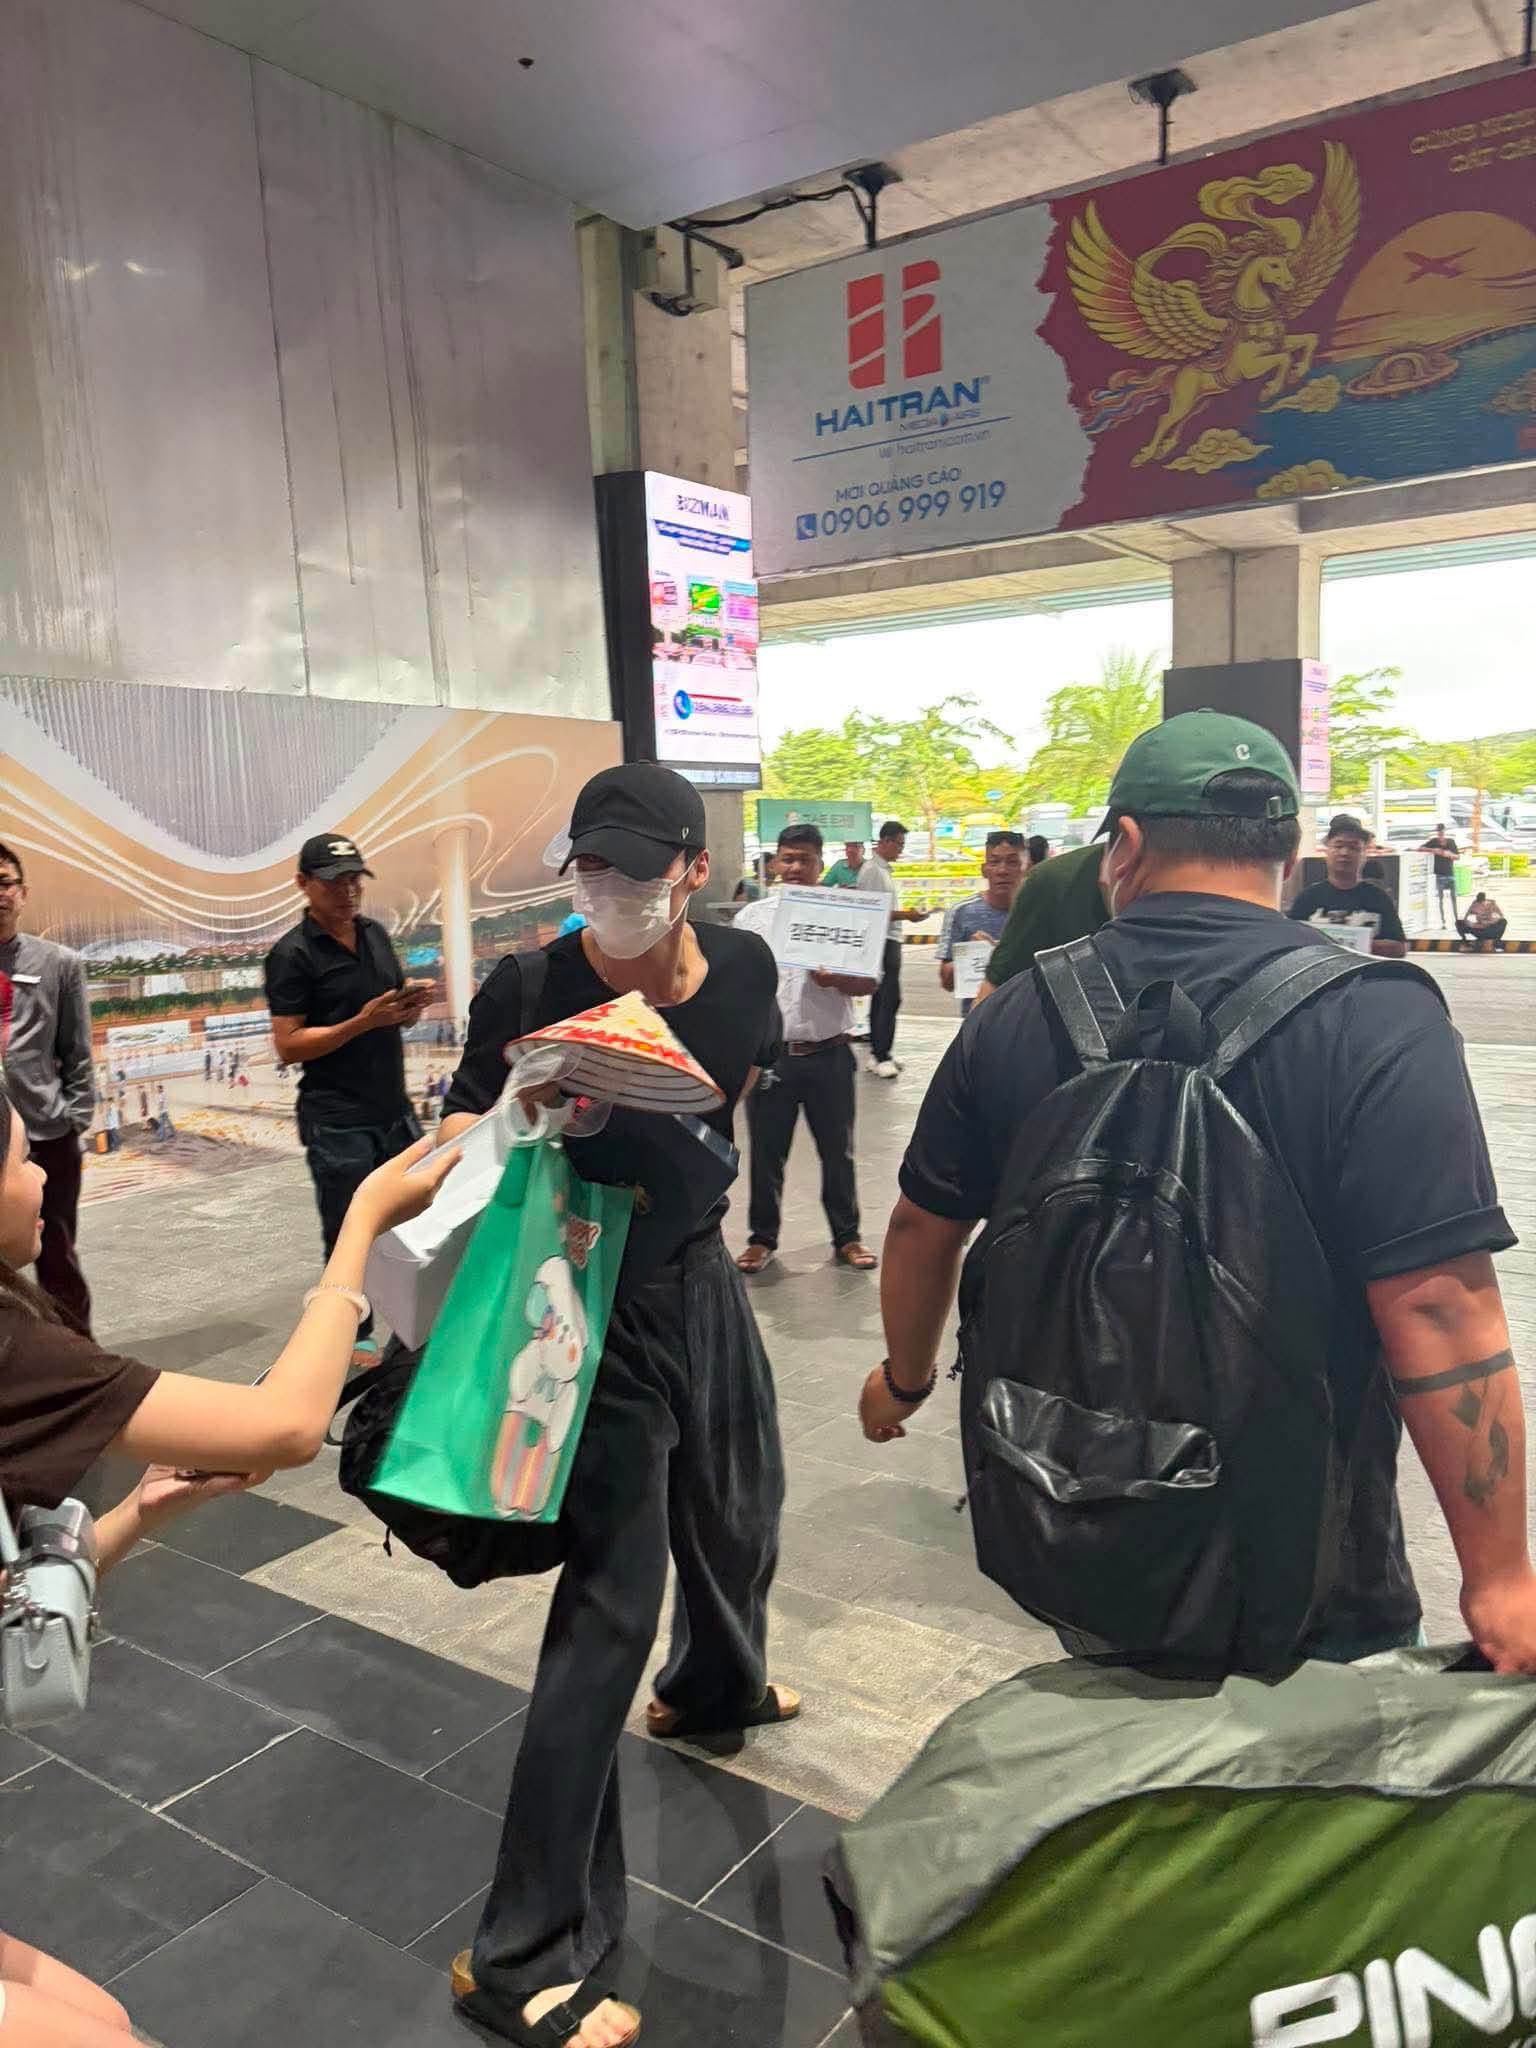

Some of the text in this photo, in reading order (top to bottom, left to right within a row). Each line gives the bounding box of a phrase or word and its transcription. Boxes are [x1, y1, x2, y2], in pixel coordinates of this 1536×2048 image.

[821, 480, 1006, 536] 0906 999 919
[1250, 1913, 1536, 2048] PIN
